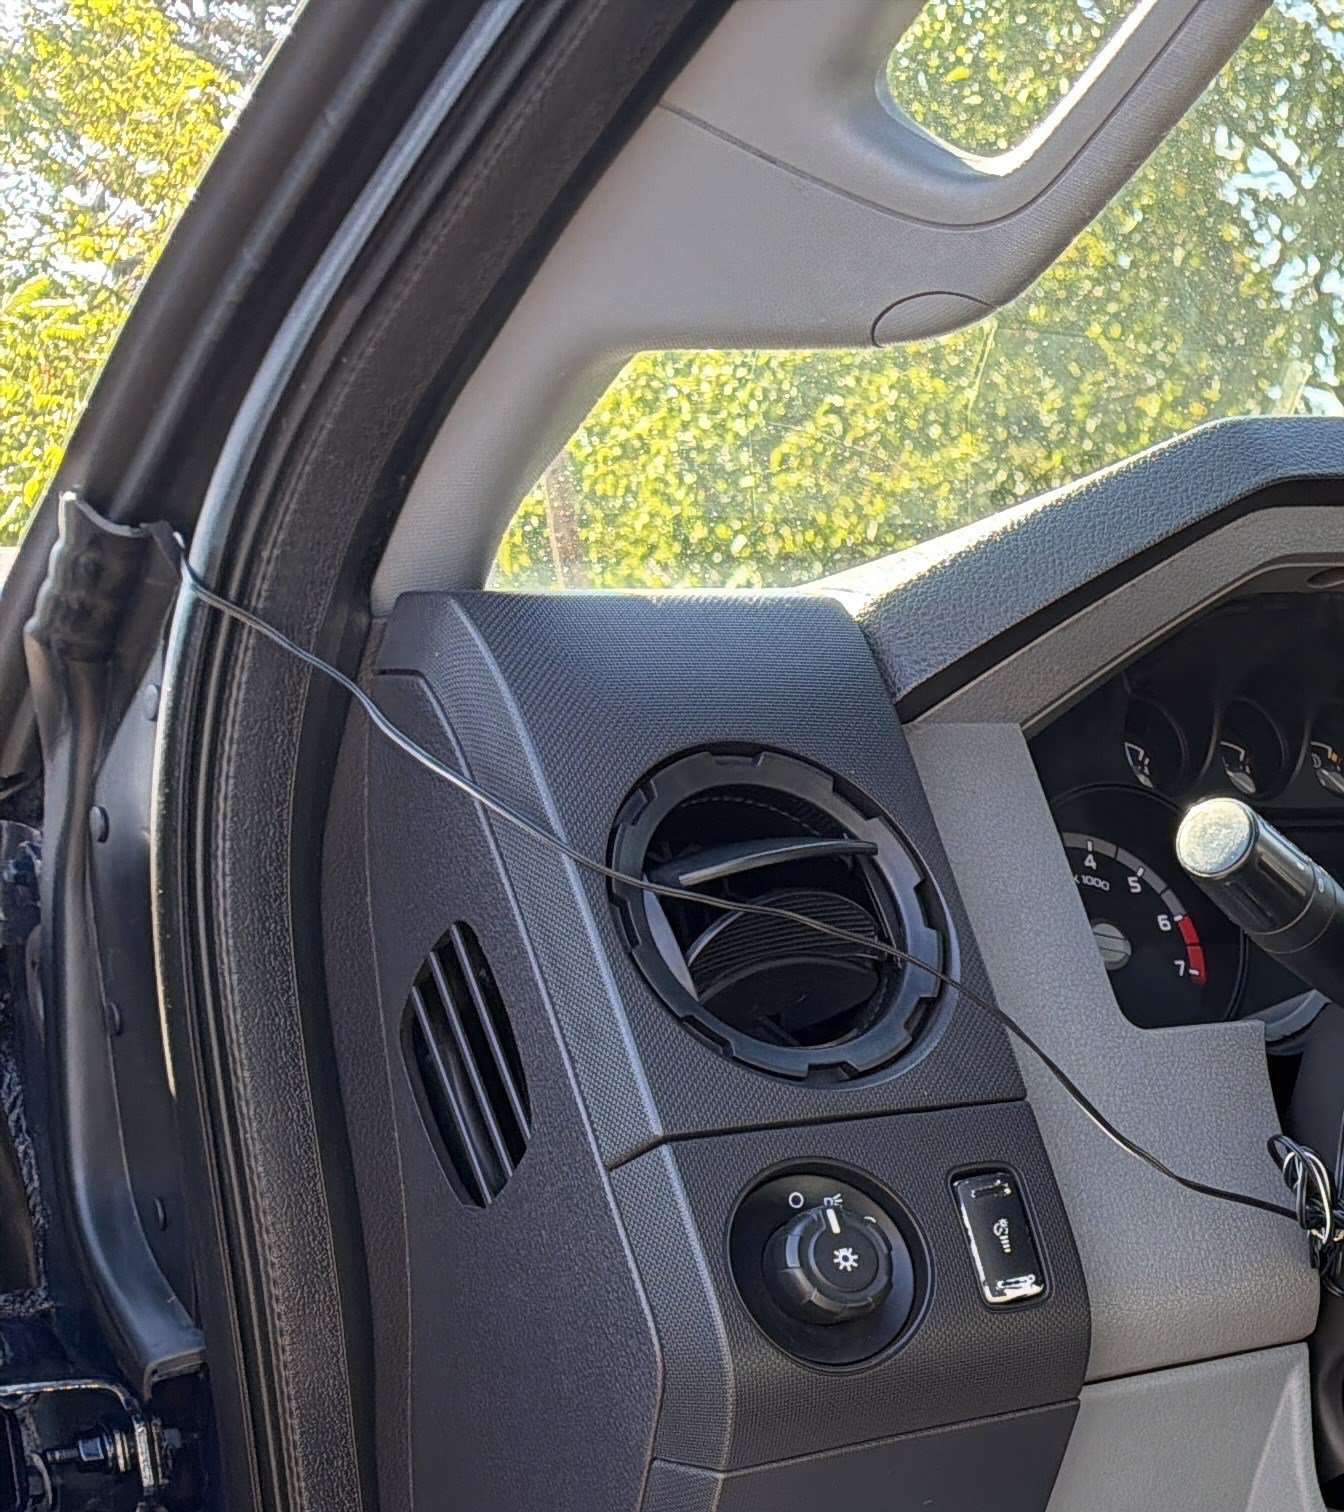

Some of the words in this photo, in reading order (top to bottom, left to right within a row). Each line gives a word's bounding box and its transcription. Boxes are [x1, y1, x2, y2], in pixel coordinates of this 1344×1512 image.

[1084, 854, 1097, 870] 4
[1082, 875, 1110, 892] 1000
[1127, 876, 1142, 893] 5
[1157, 914, 1172, 931] 6
[1174, 959, 1185, 977] 7
